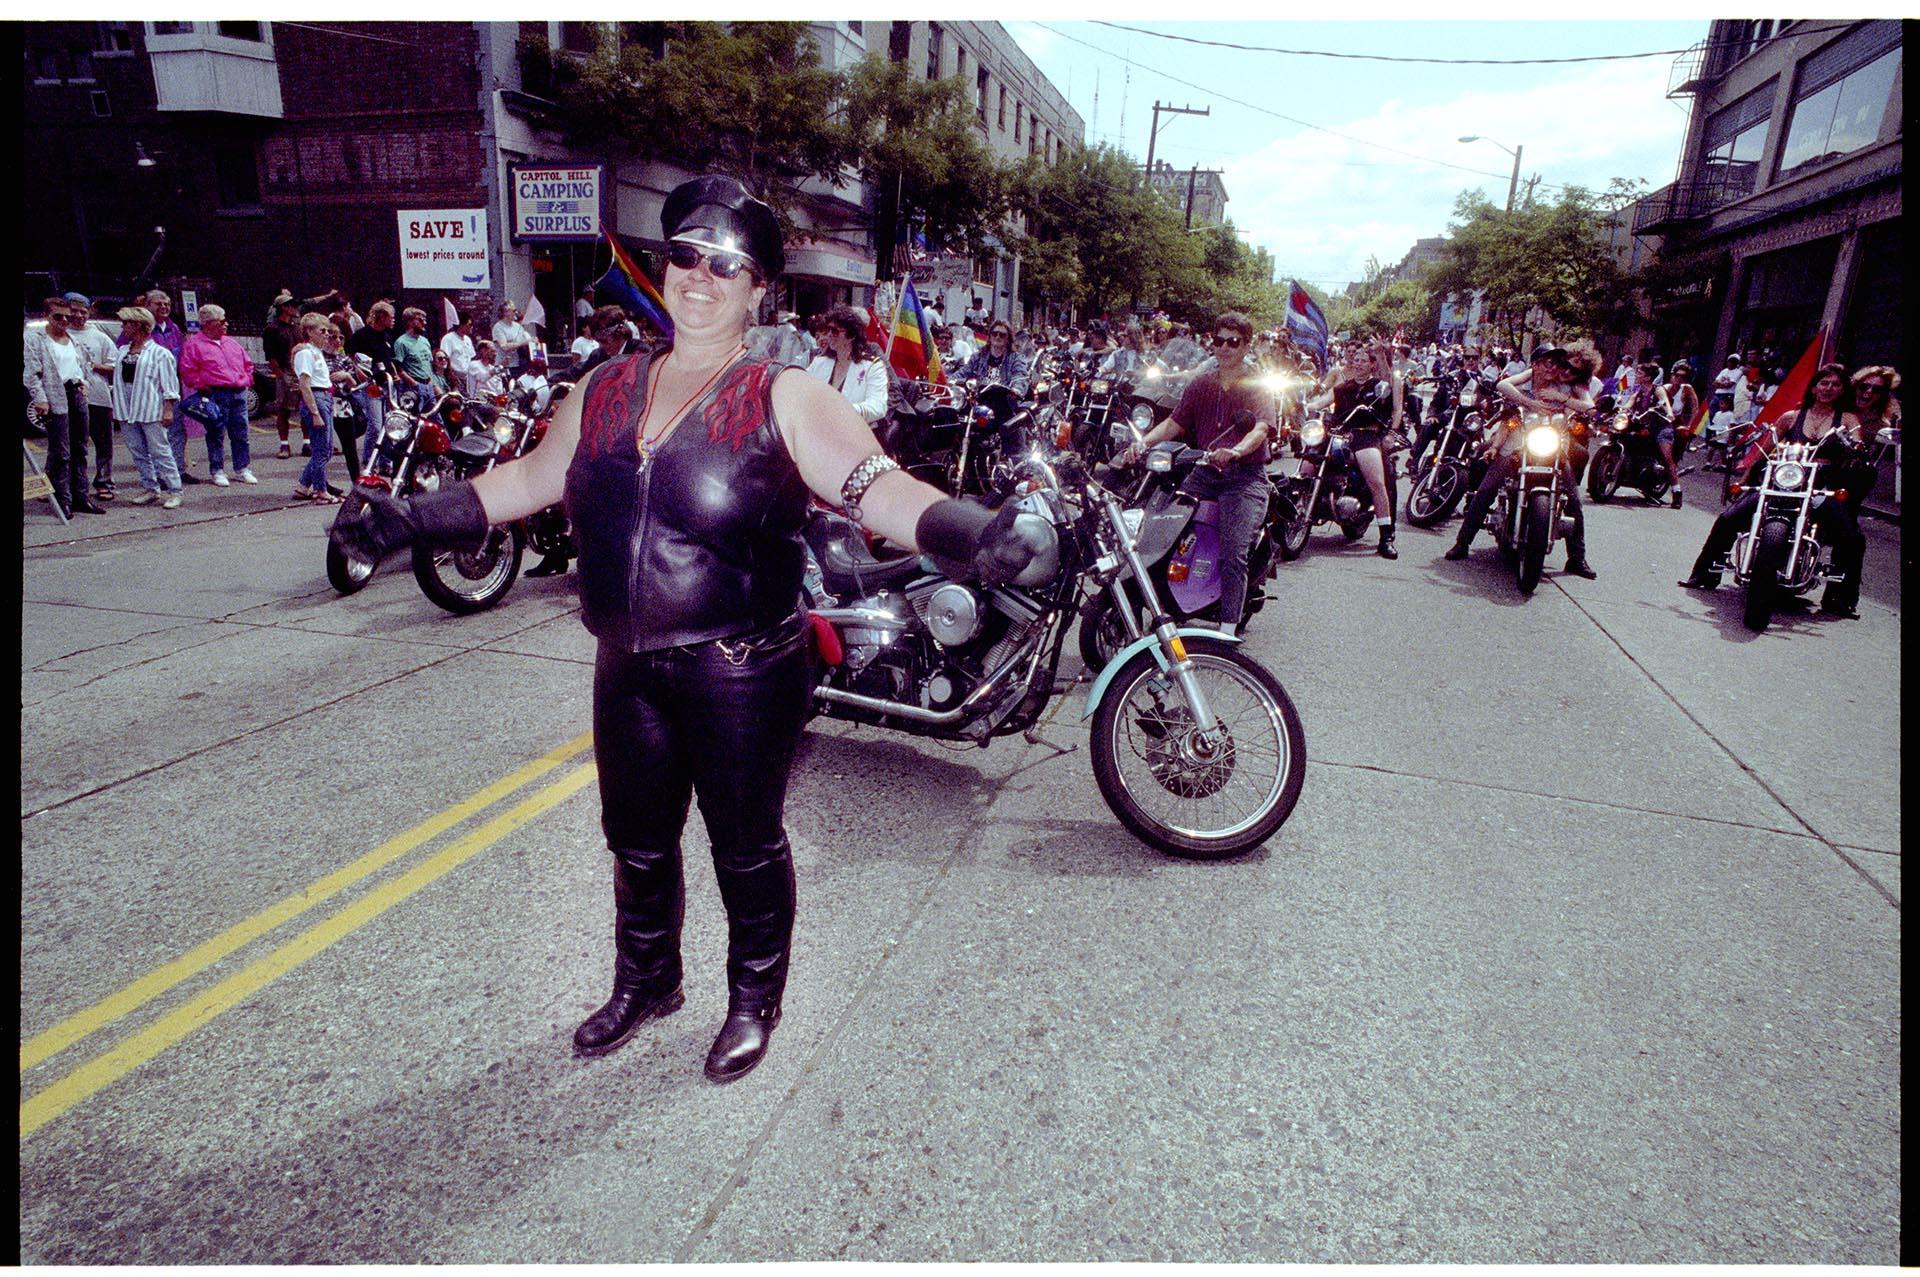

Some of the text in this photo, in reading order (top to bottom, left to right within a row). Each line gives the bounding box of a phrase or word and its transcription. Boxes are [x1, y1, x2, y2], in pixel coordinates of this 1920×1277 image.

[521, 172, 592, 180] CAPITOL HILL
[520, 182, 593, 199] CAMPING
[525, 216, 591, 232] SURPLUS
[406, 248, 484, 262] lowest prices around
